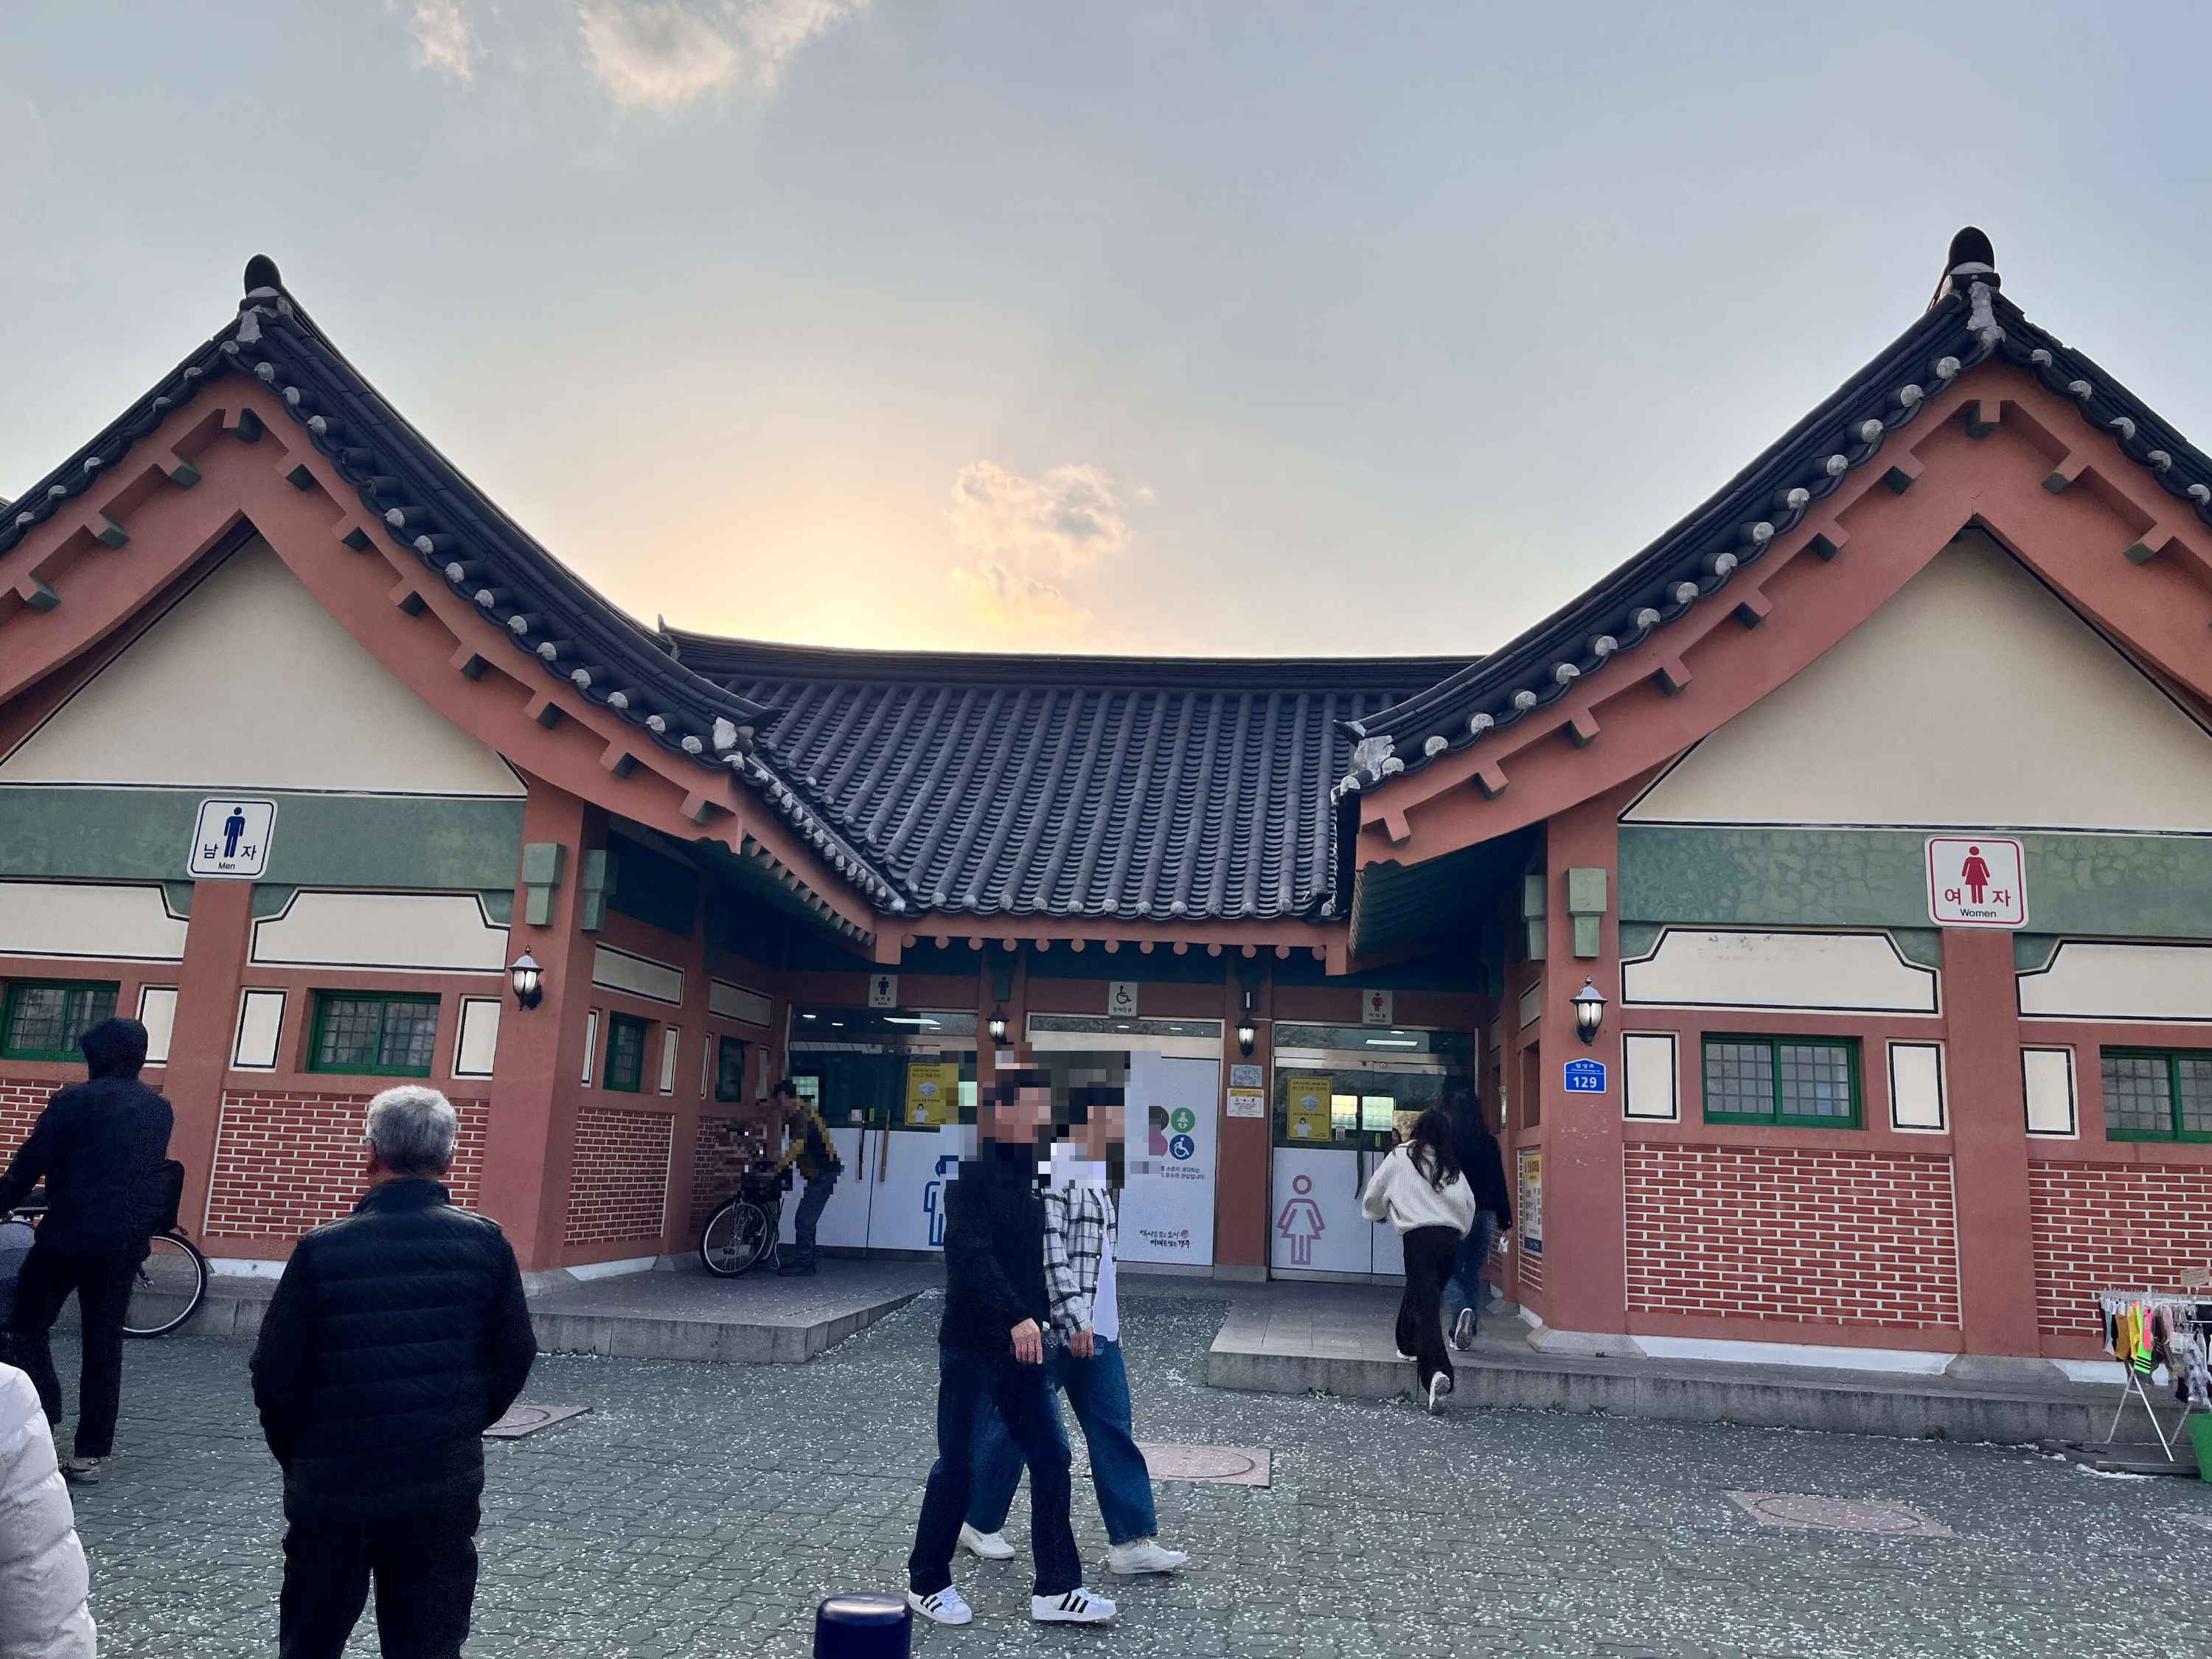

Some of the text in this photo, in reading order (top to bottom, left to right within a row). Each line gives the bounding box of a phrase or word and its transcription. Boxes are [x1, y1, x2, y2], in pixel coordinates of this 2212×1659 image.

[204, 844, 257, 860] 남 자
[1944, 888, 2011, 907] 여 자
[1960, 908, 1997, 917] Women
[1573, 1076, 1597, 1088] 129
[1167, 1231, 1179, 1239] 도시
